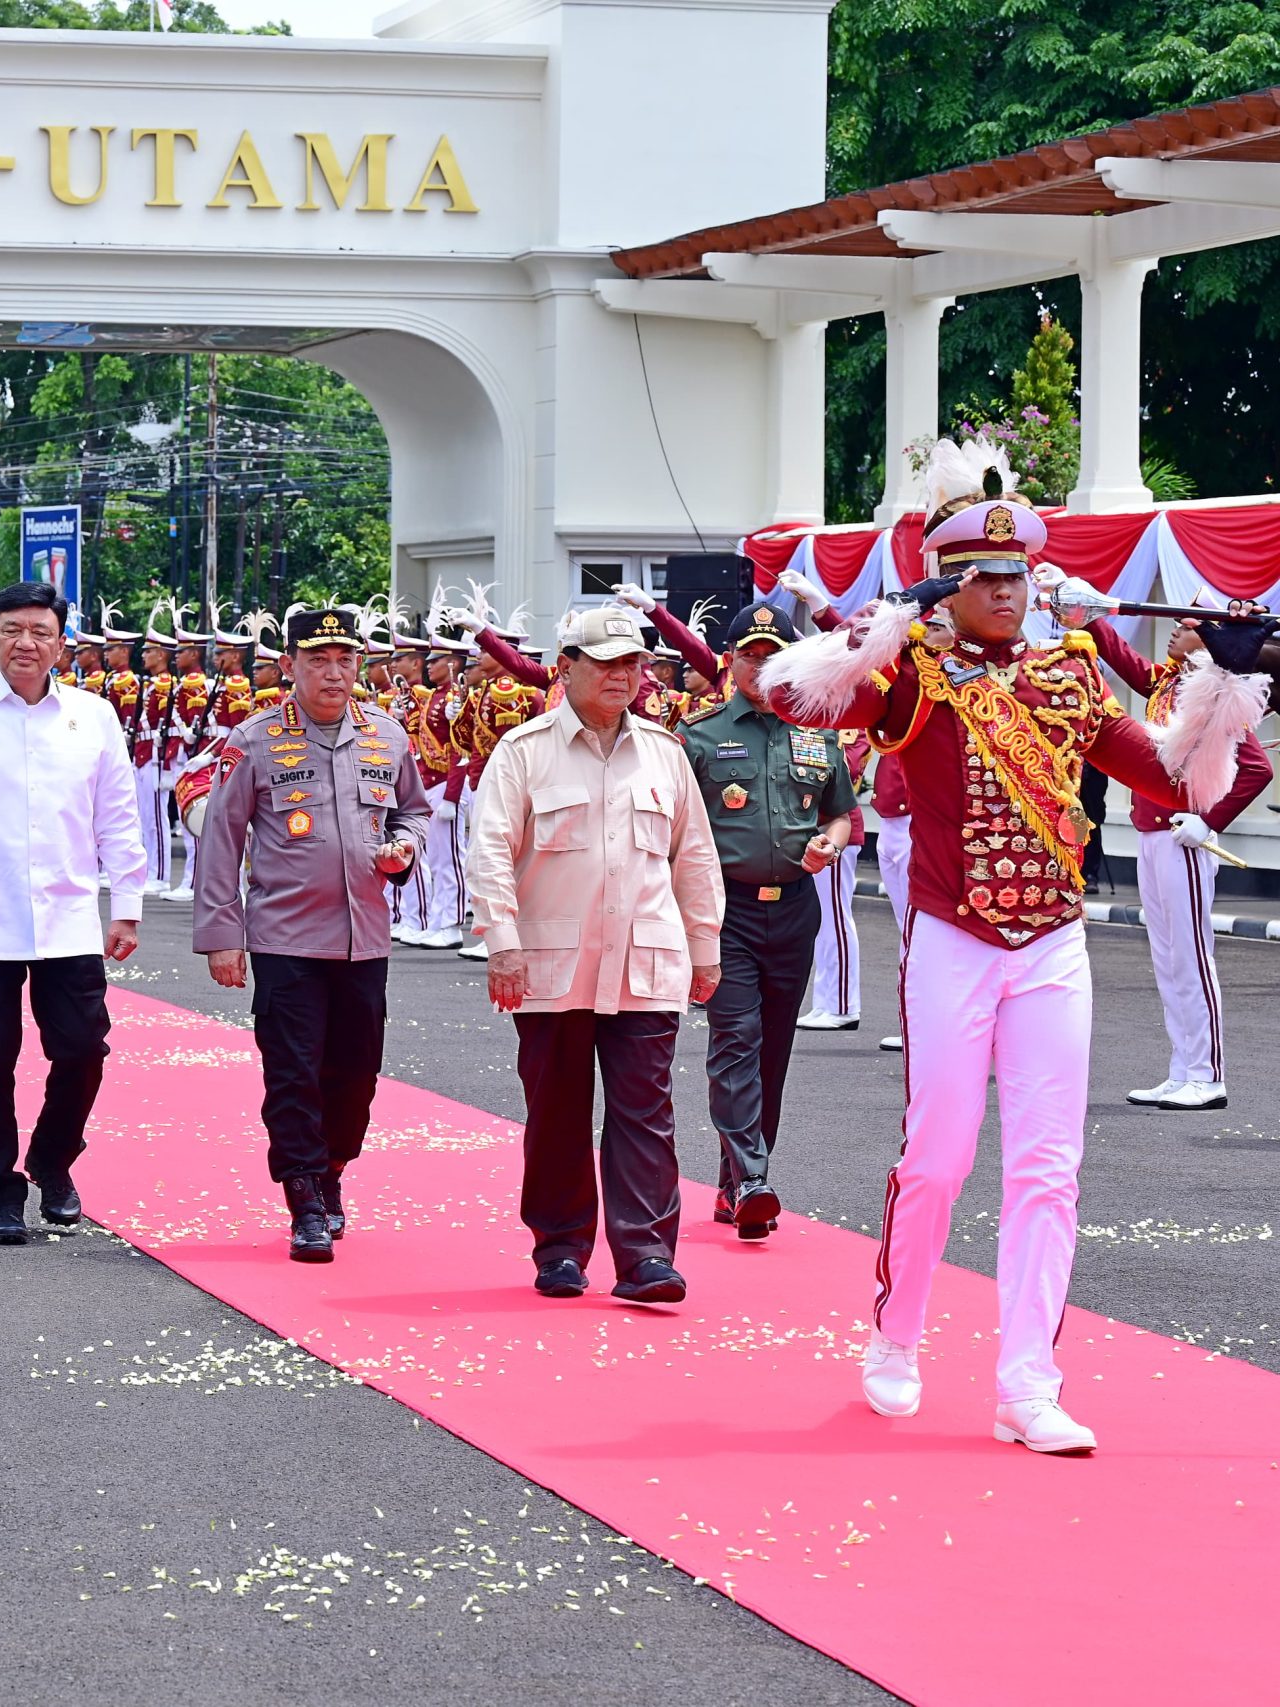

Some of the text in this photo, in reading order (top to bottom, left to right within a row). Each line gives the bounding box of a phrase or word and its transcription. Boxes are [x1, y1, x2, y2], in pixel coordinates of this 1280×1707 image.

[38, 125, 481, 215] UTAMA
[271, 769, 316, 786] L.SIGIT.P
[360, 768, 393, 782] POLRI
